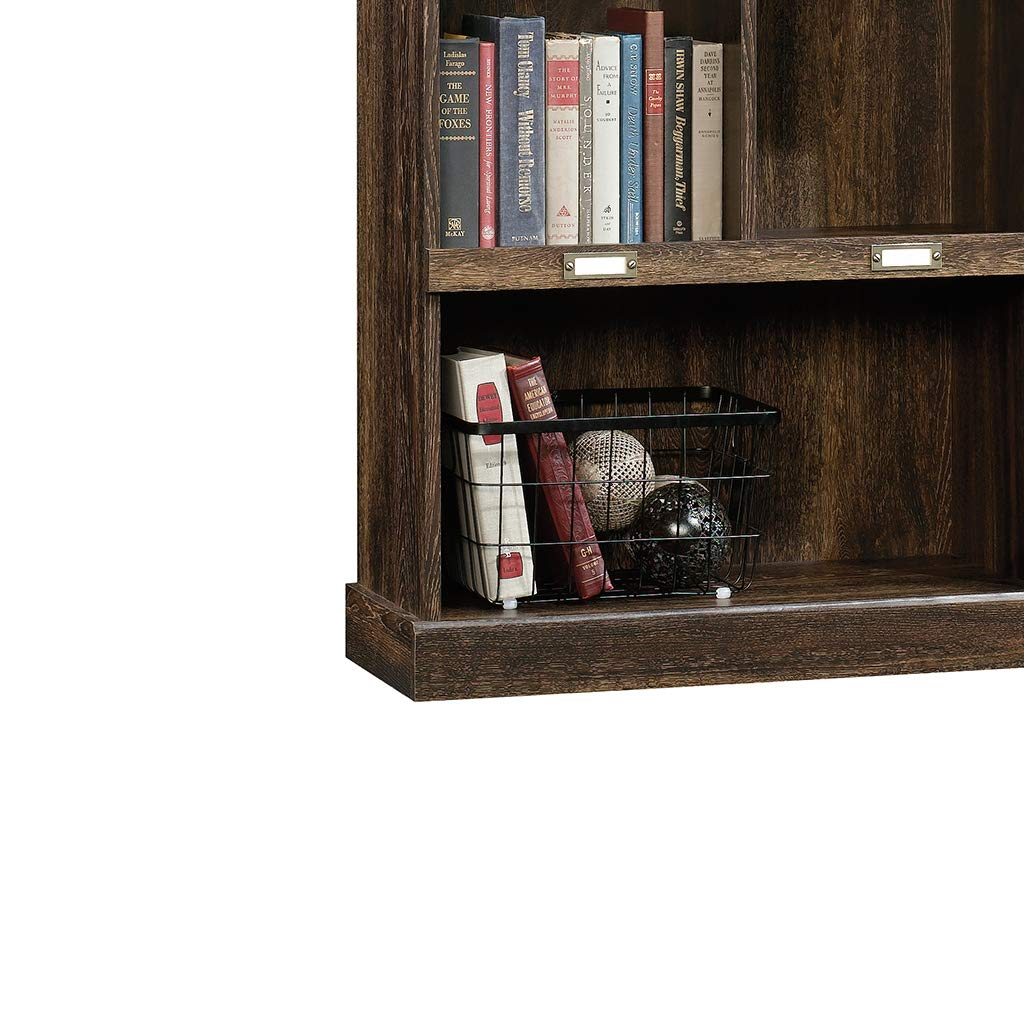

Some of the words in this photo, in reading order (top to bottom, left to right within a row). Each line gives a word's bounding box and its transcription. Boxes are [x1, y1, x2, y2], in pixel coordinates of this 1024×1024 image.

[517, 31, 534, 58] Tom
[445, 60, 465, 69] Farago
[596, 60, 617, 71] ADVICE
[676, 49, 685, 80] IRWIN
[447, 82, 463, 90] THE
[513, 60, 534, 98] Clancy
[629, 64, 637, 96] SNOW
[439, 94, 470, 104] GAME
[676, 82, 685, 112] SHAW
[453, 107, 468, 115] THE
[439, 118, 472, 129] FOXES
[517, 109, 534, 157] Without
[584, 96, 592, 193] SOUNDER
[518, 159, 535, 212] Remorse
[528, 376, 538, 387] THE
[524, 386, 547, 401] AMERICAN
[526, 396, 551, 413] EDUCATOR
[580, 545, 593, 558] G-H
[582, 560, 600, 571] VOLUME
